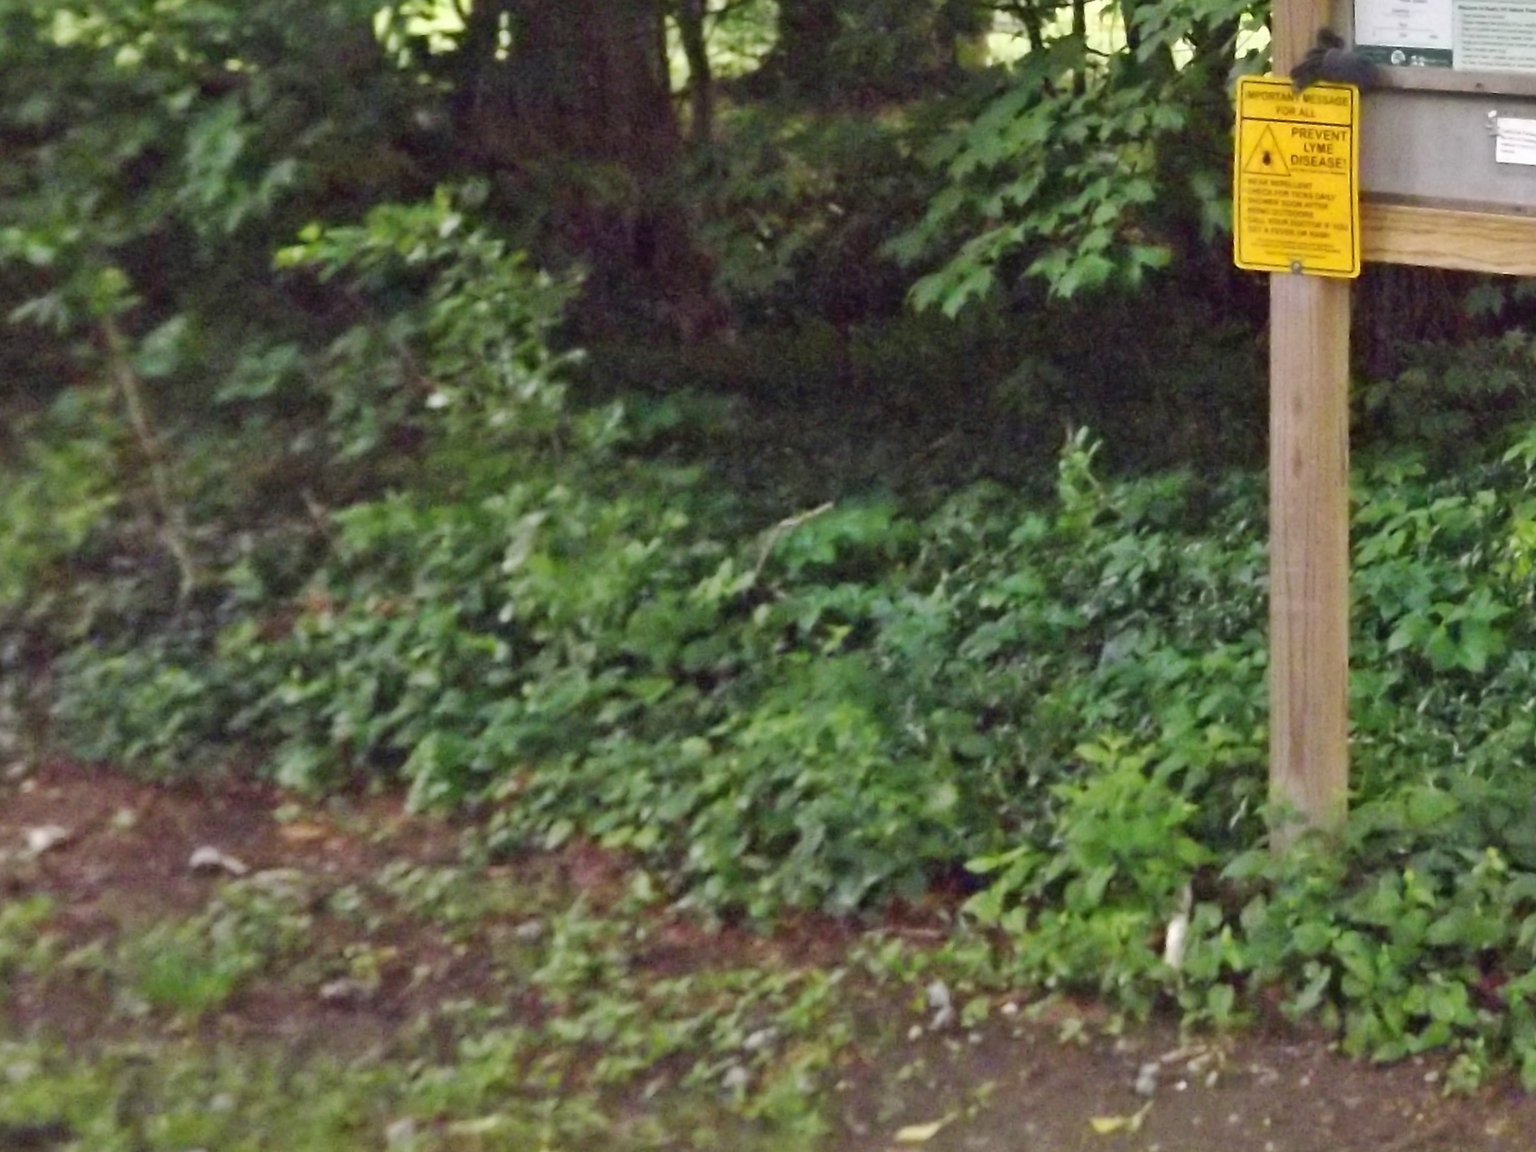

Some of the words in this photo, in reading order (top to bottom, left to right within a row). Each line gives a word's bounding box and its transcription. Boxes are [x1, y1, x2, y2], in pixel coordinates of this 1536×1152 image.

[1245, 91, 1299, 101] IMPORTANT
[1302, 93, 1349, 106] MESSAGE
[1276, 105, 1296, 116] FOR
[1298, 107, 1316, 118] ALL
[1291, 127, 1347, 141] PREVENT
[1303, 143, 1333, 154] LYME
